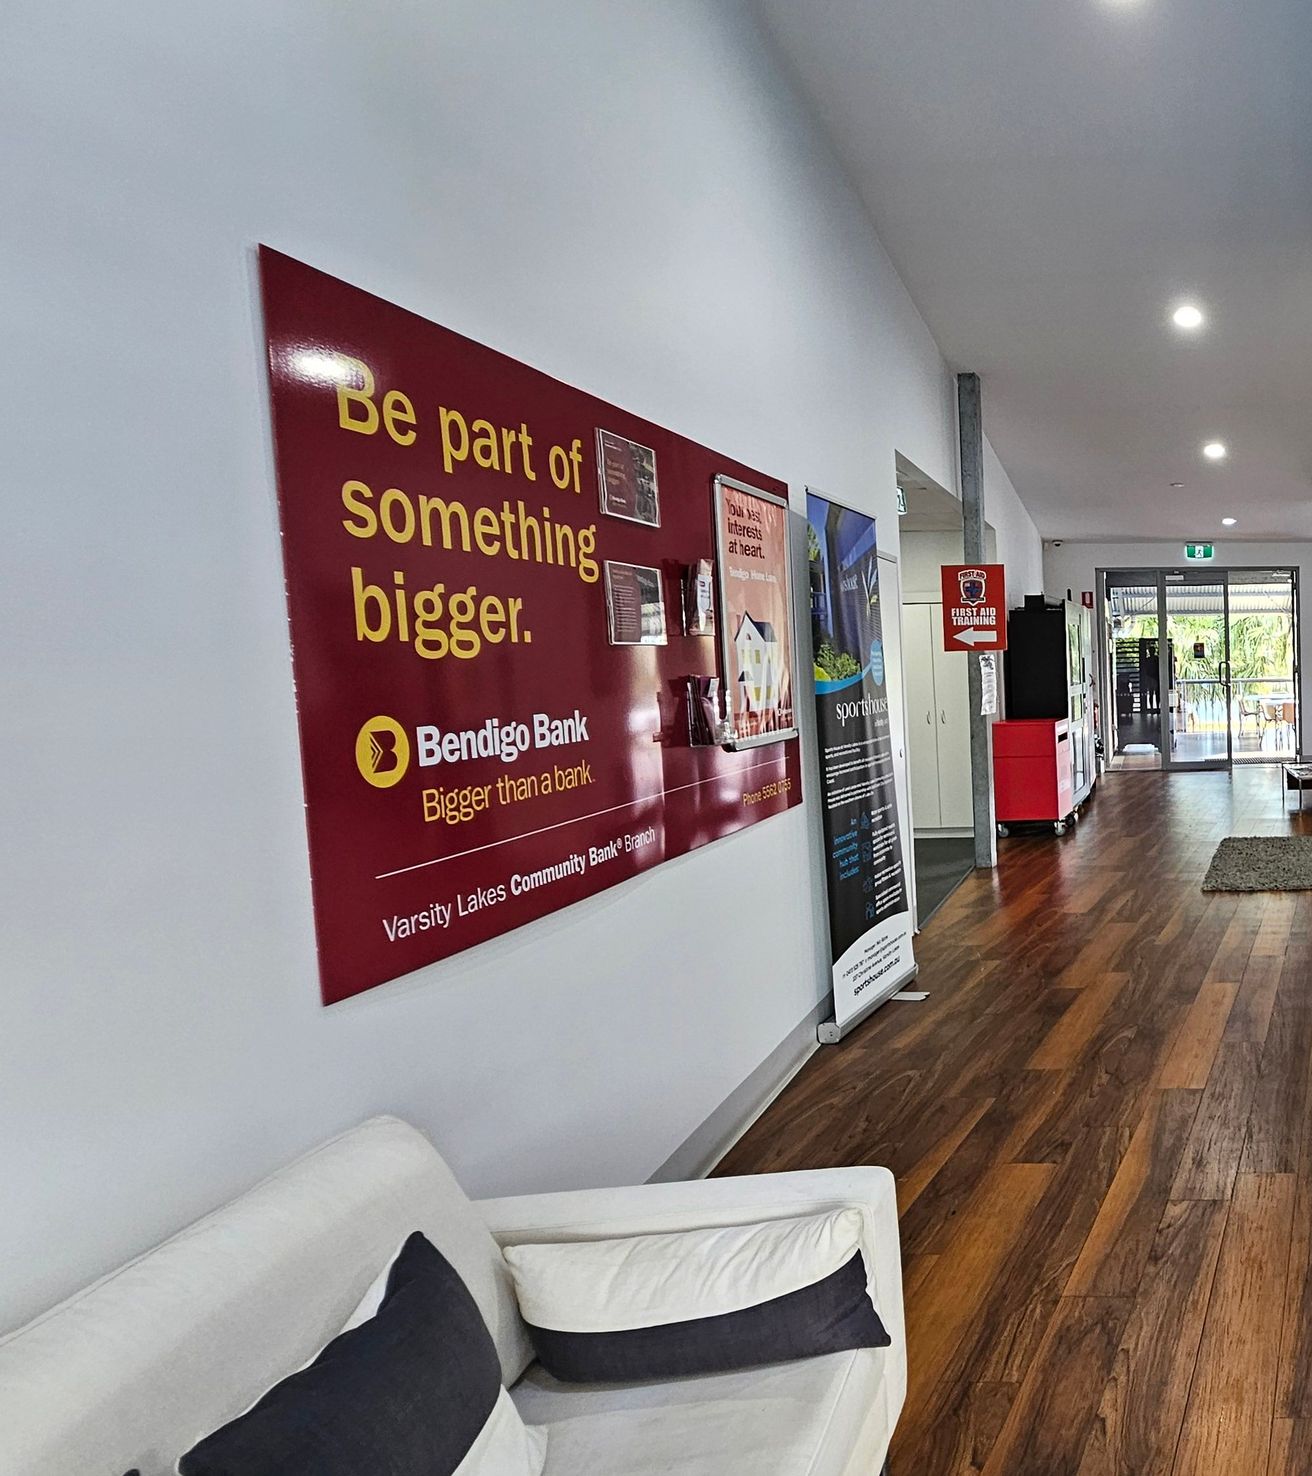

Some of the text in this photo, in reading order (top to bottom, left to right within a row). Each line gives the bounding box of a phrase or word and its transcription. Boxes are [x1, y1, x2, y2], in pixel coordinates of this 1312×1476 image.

[336, 352, 417, 446] Be
[439, 406, 537, 481] part
[549, 439, 582, 493] of
[341, 480, 600, 584] something
[727, 516, 763, 541] interests
[728, 538, 766, 559] at heart.
[351, 567, 532, 660] bigger.
[951, 607, 997, 617] FIRST AID
[952, 616, 996, 626] TRAINING
[836, 693, 889, 727] sportshouse
[416, 709, 590, 768] Bendigo Bank
[421, 783, 492, 825] Bigger
[495, 774, 538, 806] than
[540, 772, 552, 795] a
[743, 790, 762, 807] Phone
[382, 902, 452, 942] Varsity
[456, 882, 507, 917] Lakes
[510, 853, 587, 896] Community
[624, 826, 656, 853] Branch
